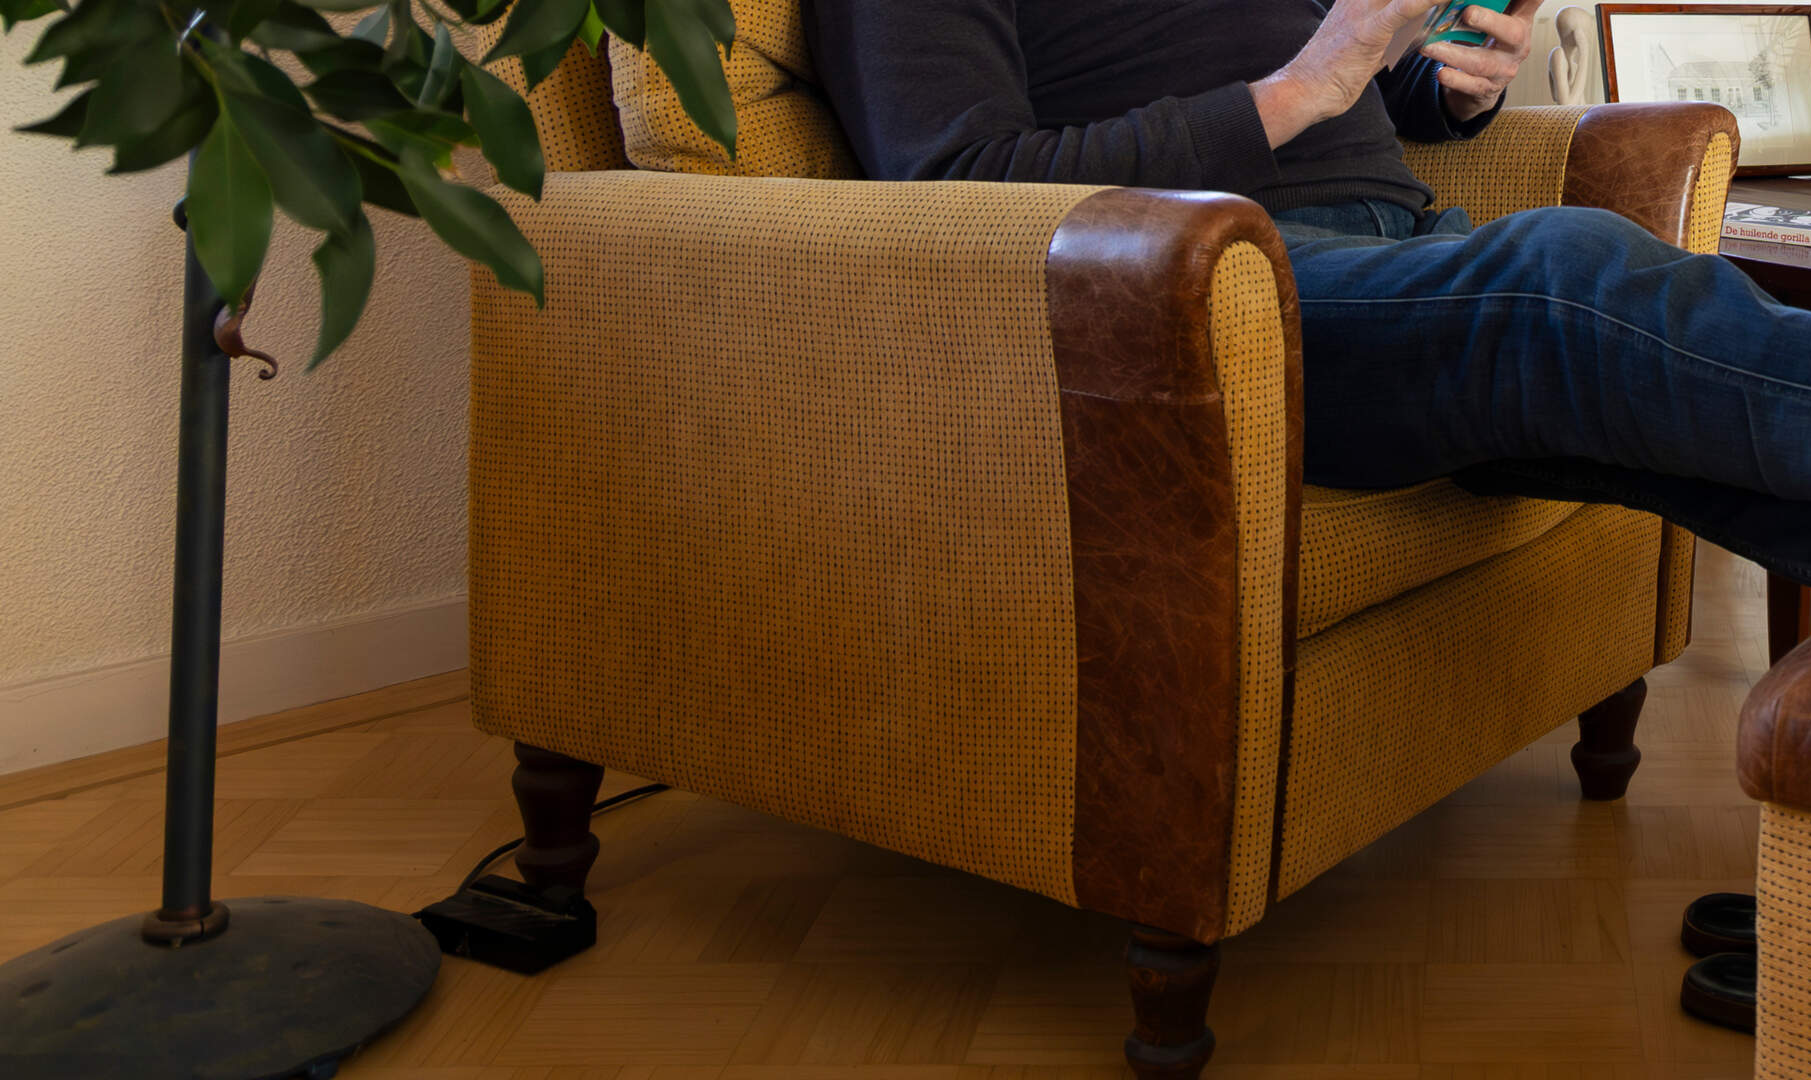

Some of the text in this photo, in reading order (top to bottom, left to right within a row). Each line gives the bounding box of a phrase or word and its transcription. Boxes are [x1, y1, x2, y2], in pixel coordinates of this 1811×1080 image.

[1725, 226, 1810, 243] De huilende gorilla
